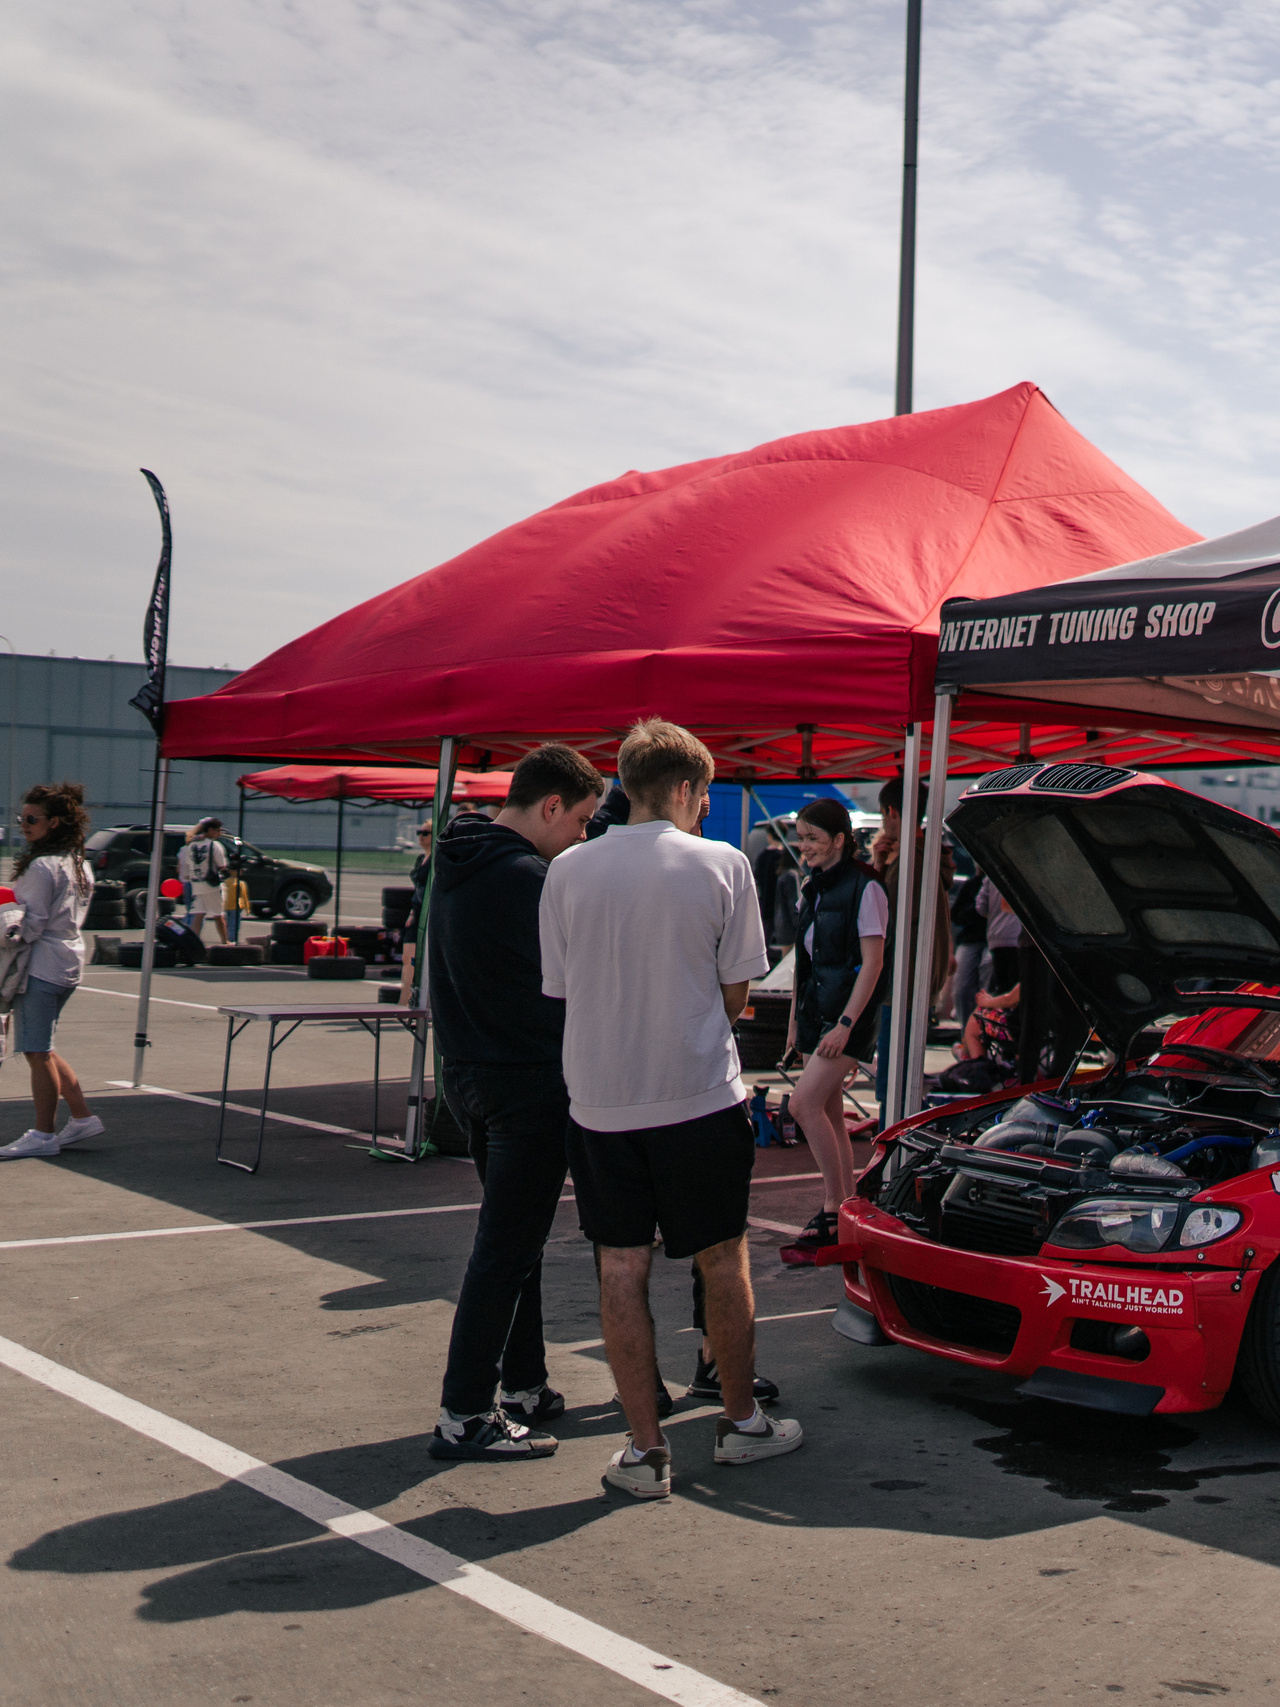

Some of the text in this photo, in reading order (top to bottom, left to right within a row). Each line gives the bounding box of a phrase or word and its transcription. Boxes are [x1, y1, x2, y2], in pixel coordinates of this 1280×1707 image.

[1048, 607, 1136, 646] TUNING
[1144, 601, 1216, 639] SHOP
[1068, 1279, 1184, 1307] TRAILHEAD
[1071, 1297, 1184, 1315] AIN'T TALKING JUST WORKING
